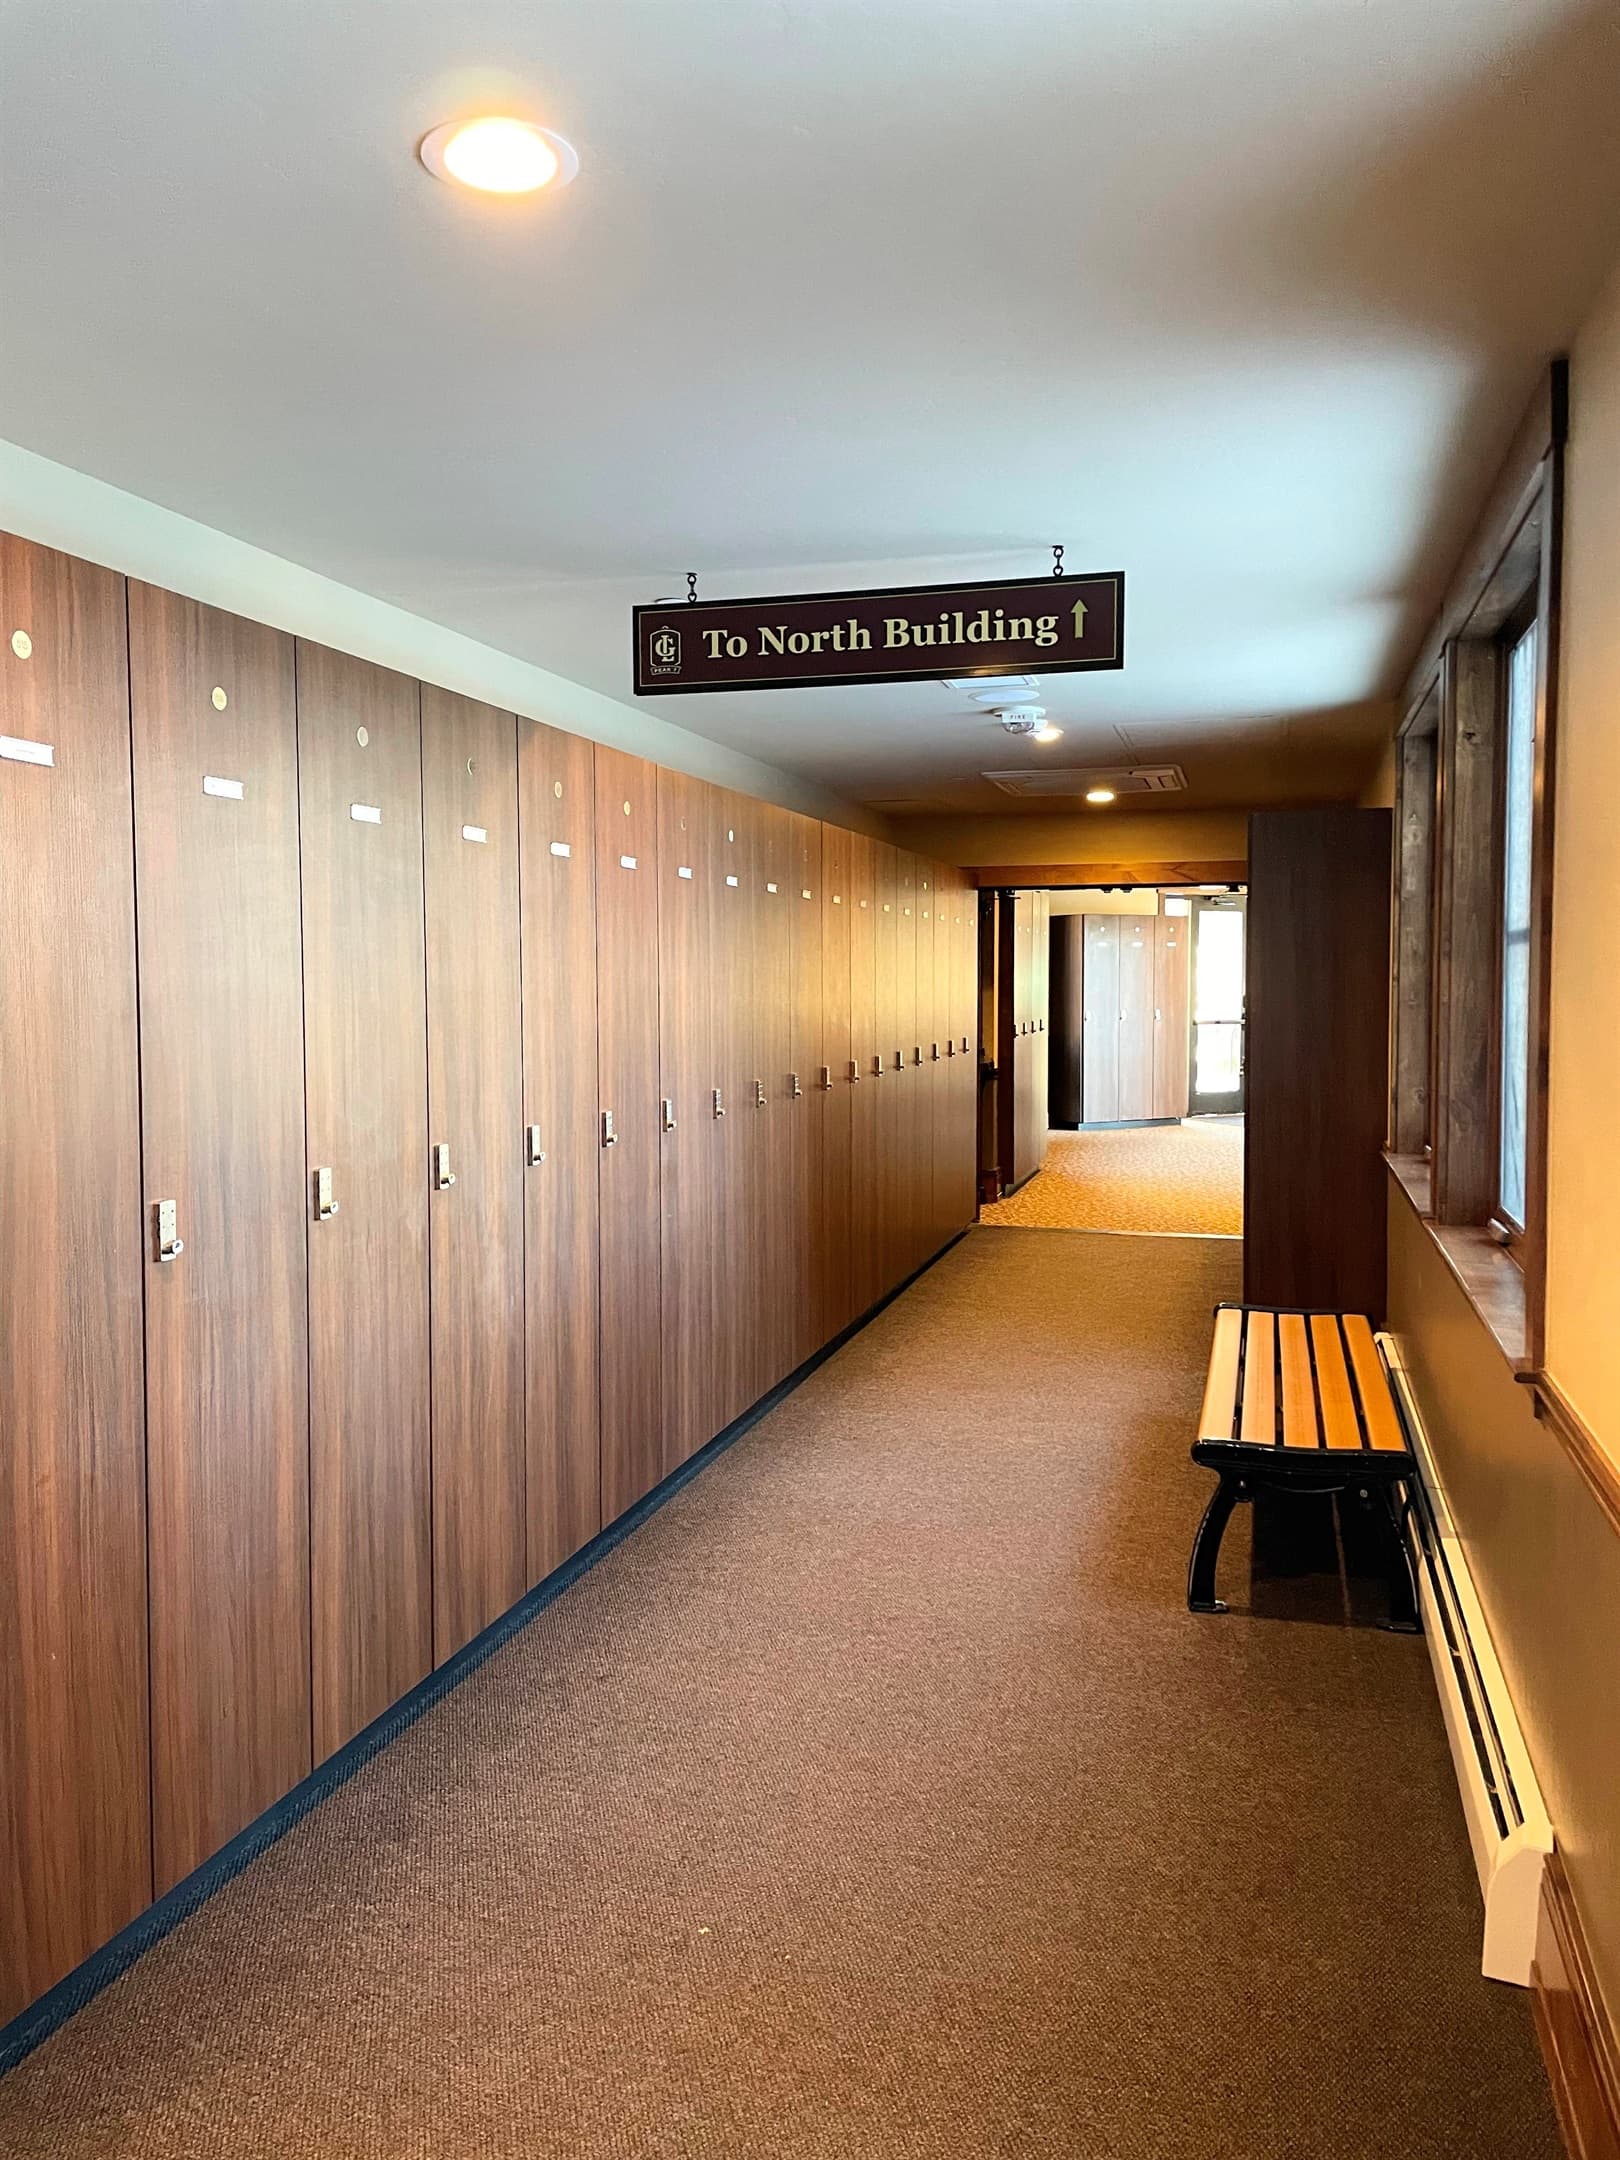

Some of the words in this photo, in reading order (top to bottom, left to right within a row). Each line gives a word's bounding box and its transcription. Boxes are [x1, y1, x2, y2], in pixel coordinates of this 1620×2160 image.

[702, 629, 748, 658] To
[757, 619, 873, 655] North
[883, 609, 1059, 647] Building
